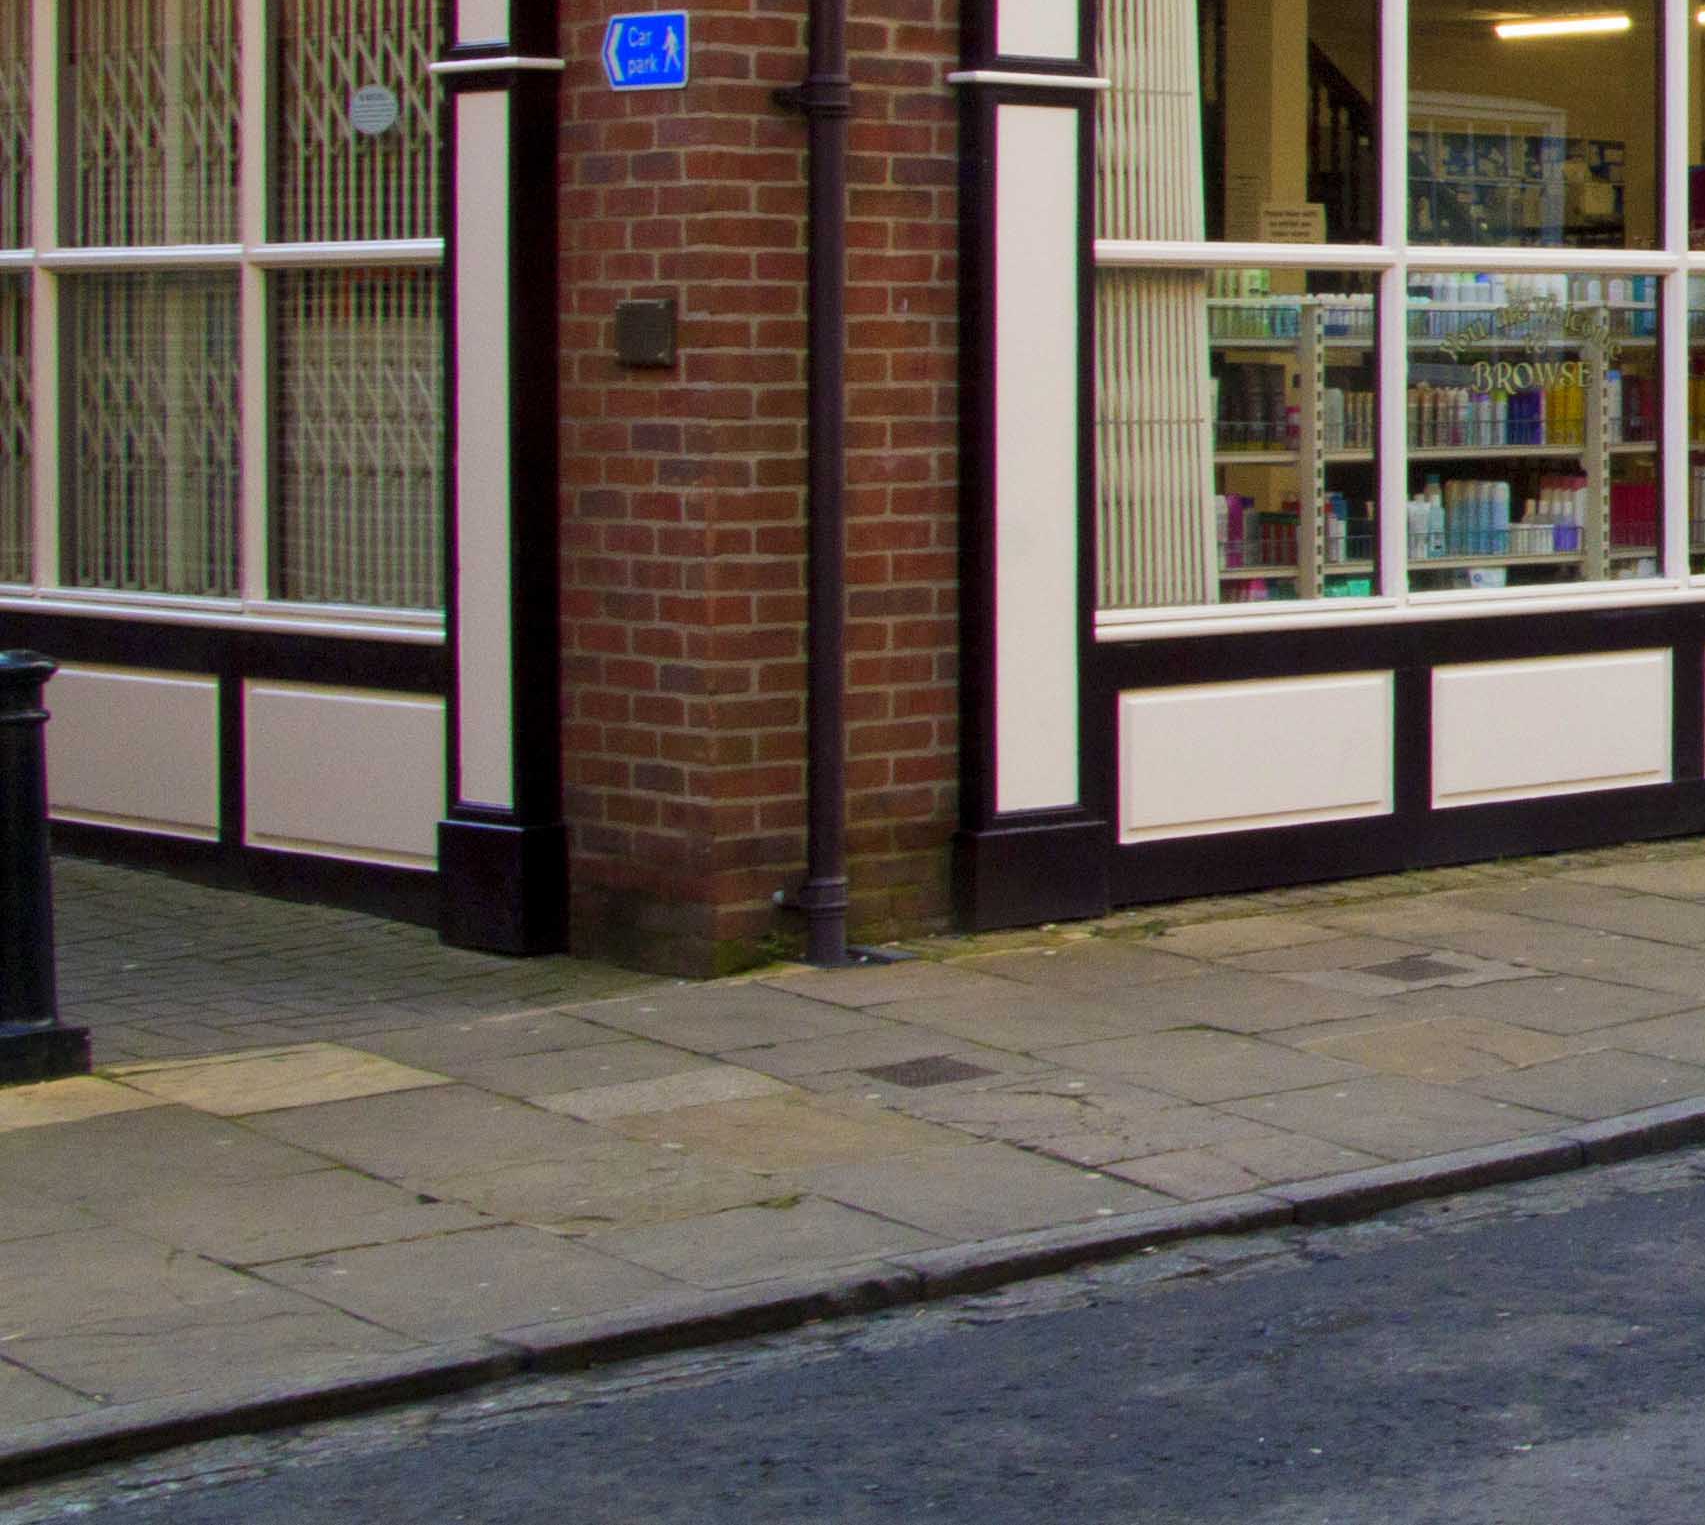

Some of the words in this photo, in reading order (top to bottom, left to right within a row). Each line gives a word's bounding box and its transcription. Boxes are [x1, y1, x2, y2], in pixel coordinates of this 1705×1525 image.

[627, 25, 653, 48] Car
[627, 53, 658, 77] park
[1471, 360, 1594, 396] BROWSE
